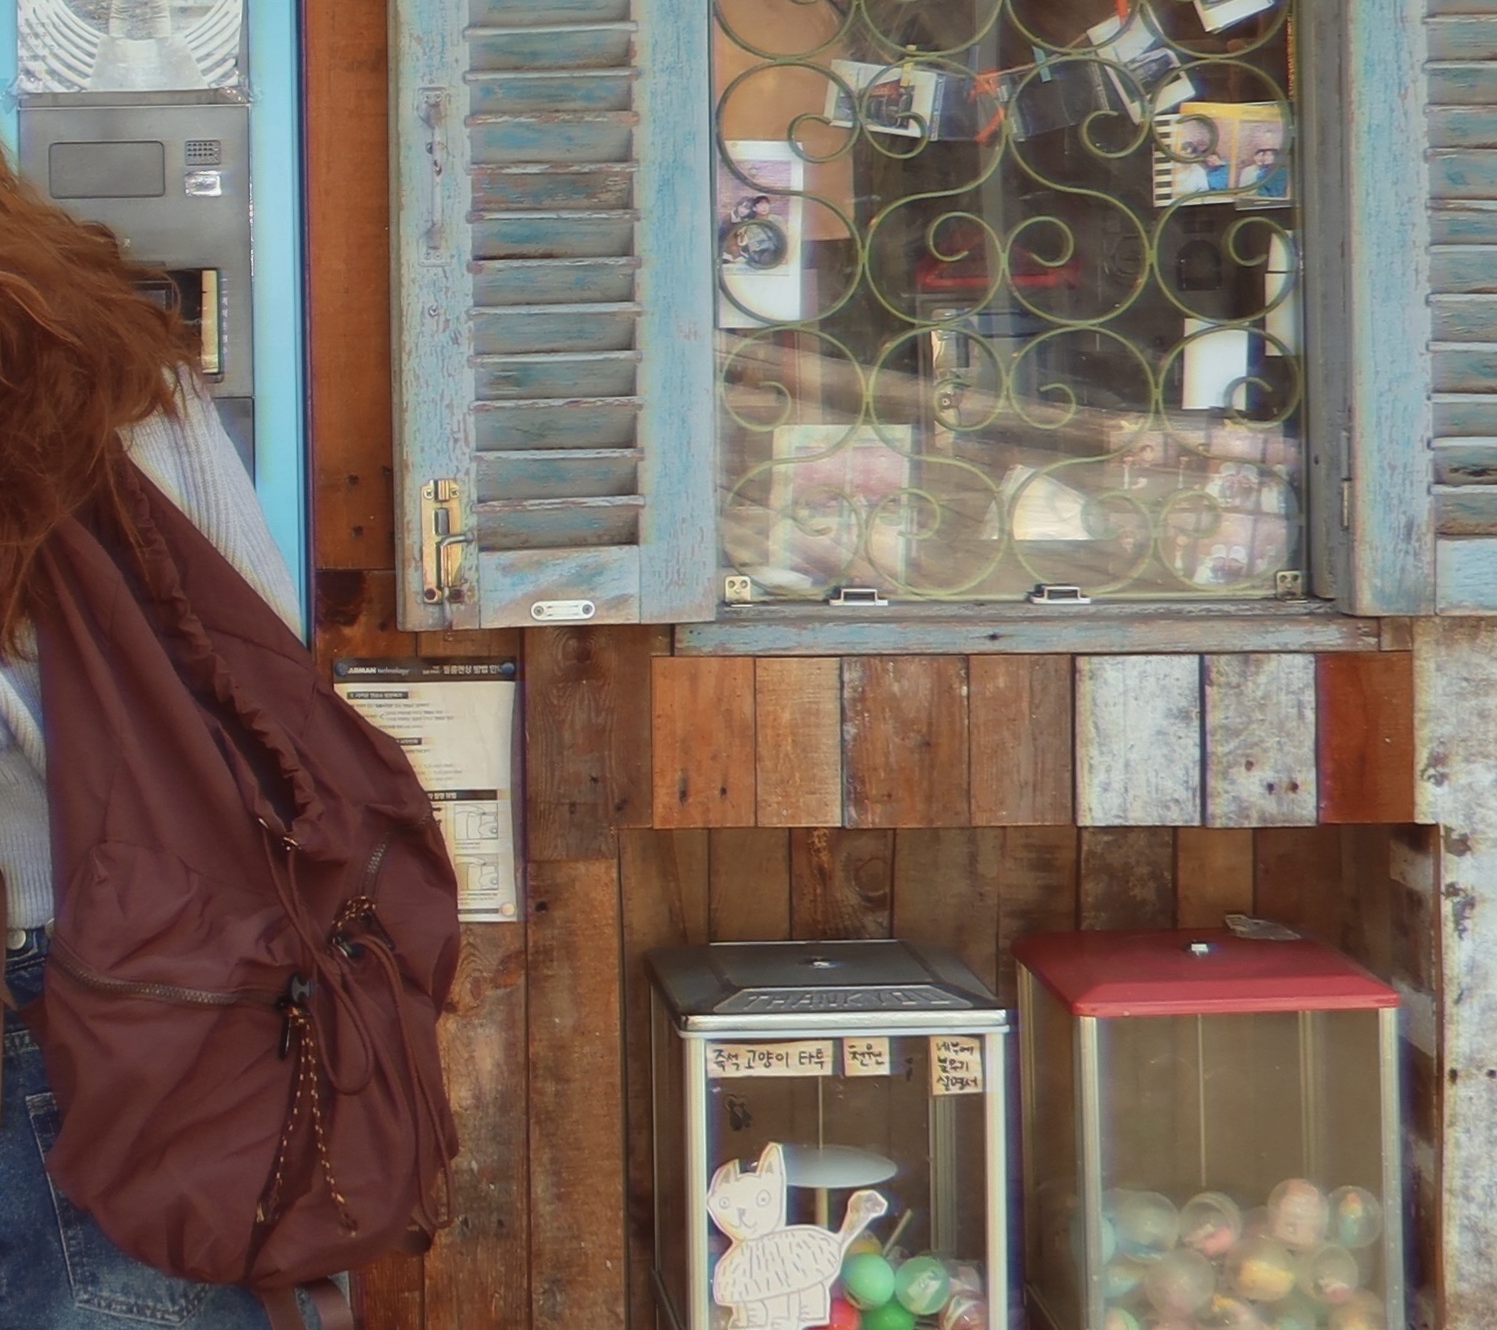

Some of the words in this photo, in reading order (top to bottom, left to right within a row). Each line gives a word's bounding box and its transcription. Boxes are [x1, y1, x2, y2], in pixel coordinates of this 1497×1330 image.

[744, 992, 863, 1011] THANK
[875, 990, 951, 1007] YOU
[712, 1048, 740, 1072] 즉석
[744, 1048, 790, 1069] 고양이
[798, 1047, 825, 1069] 타투
[848, 1043, 885, 1068] 천원
